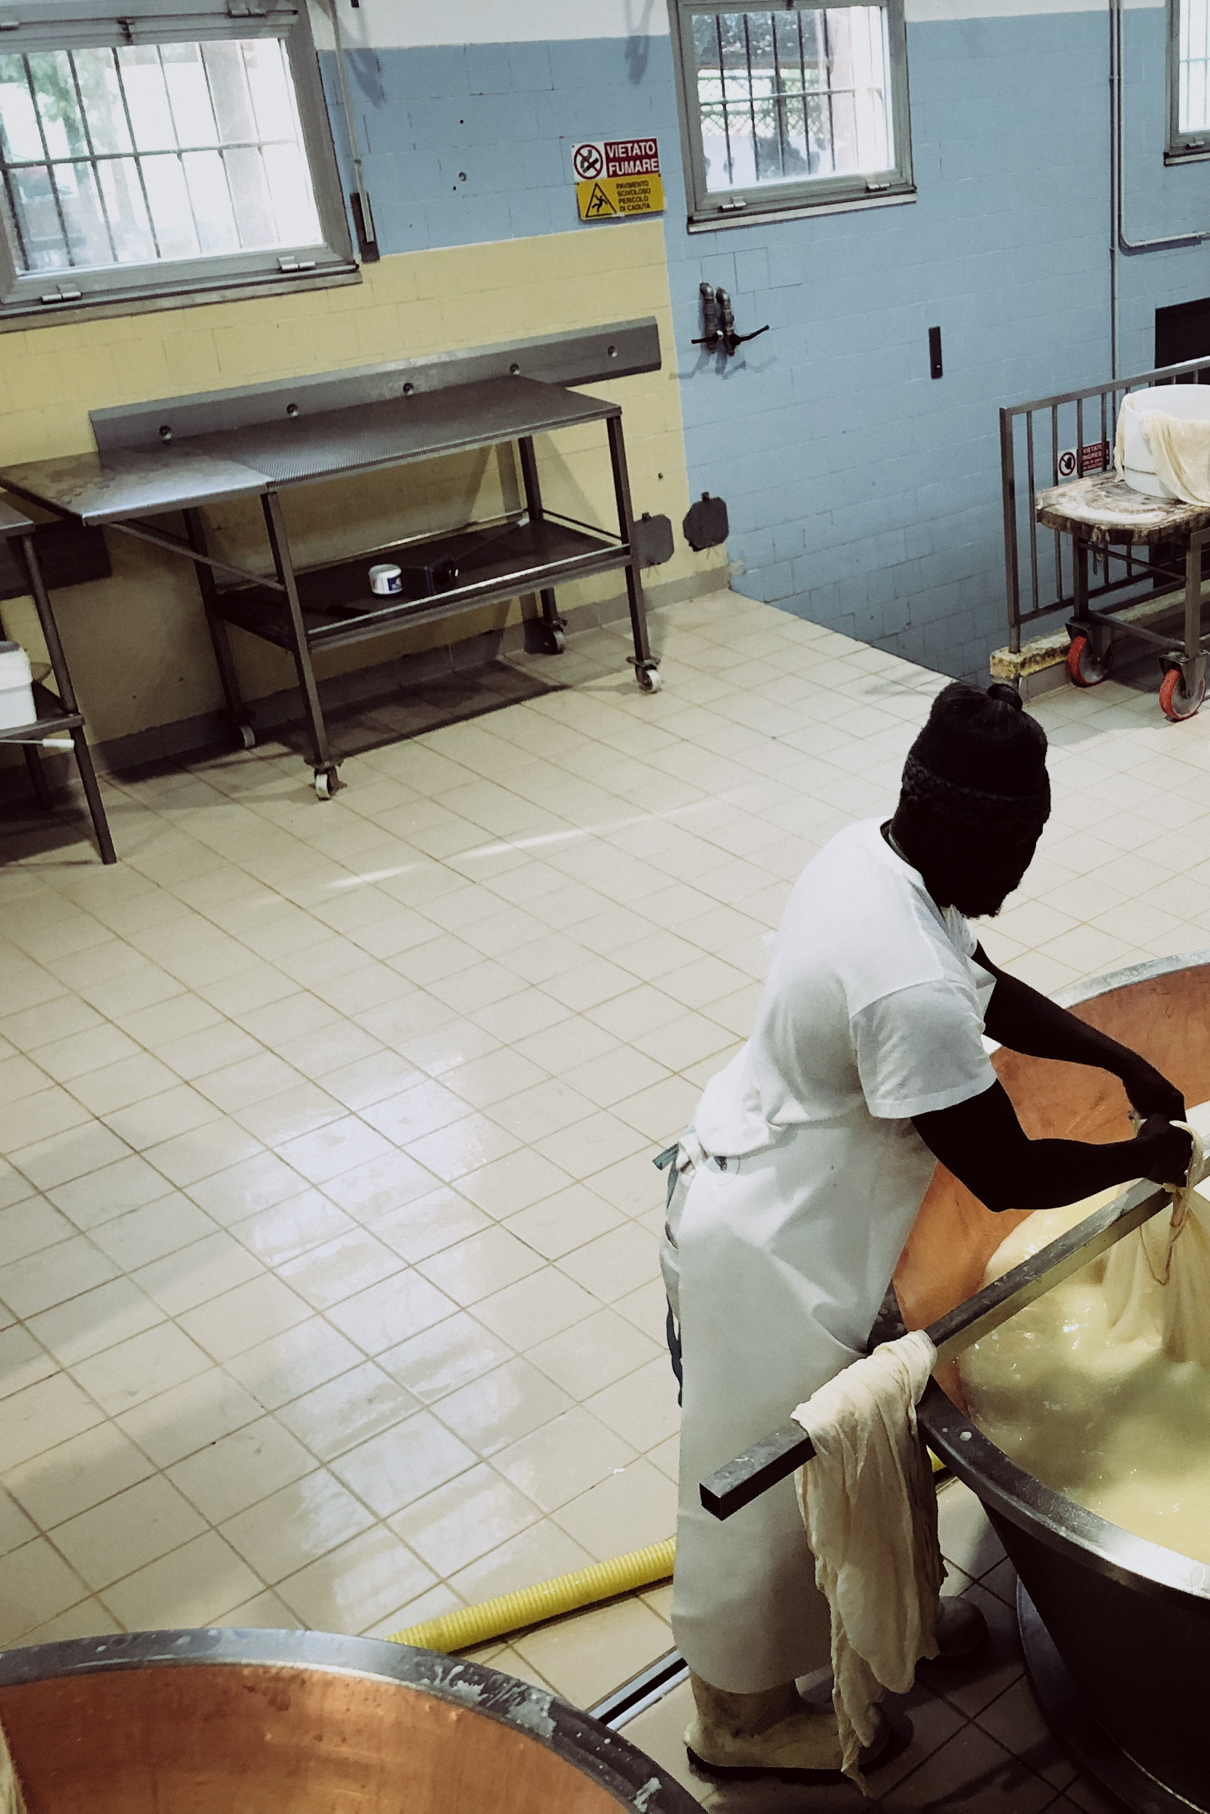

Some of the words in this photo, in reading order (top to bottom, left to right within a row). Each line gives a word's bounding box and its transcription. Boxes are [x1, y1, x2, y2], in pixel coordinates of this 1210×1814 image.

[606, 141, 655, 158] VIETATO
[608, 159, 659, 176] FUMARE
[616, 180, 649, 189] PAVIMENTO
[617, 188, 651, 197] SCIVOLOSO
[618, 196, 649, 204] PERICOLO
[627, 203, 651, 211] CADUTA
